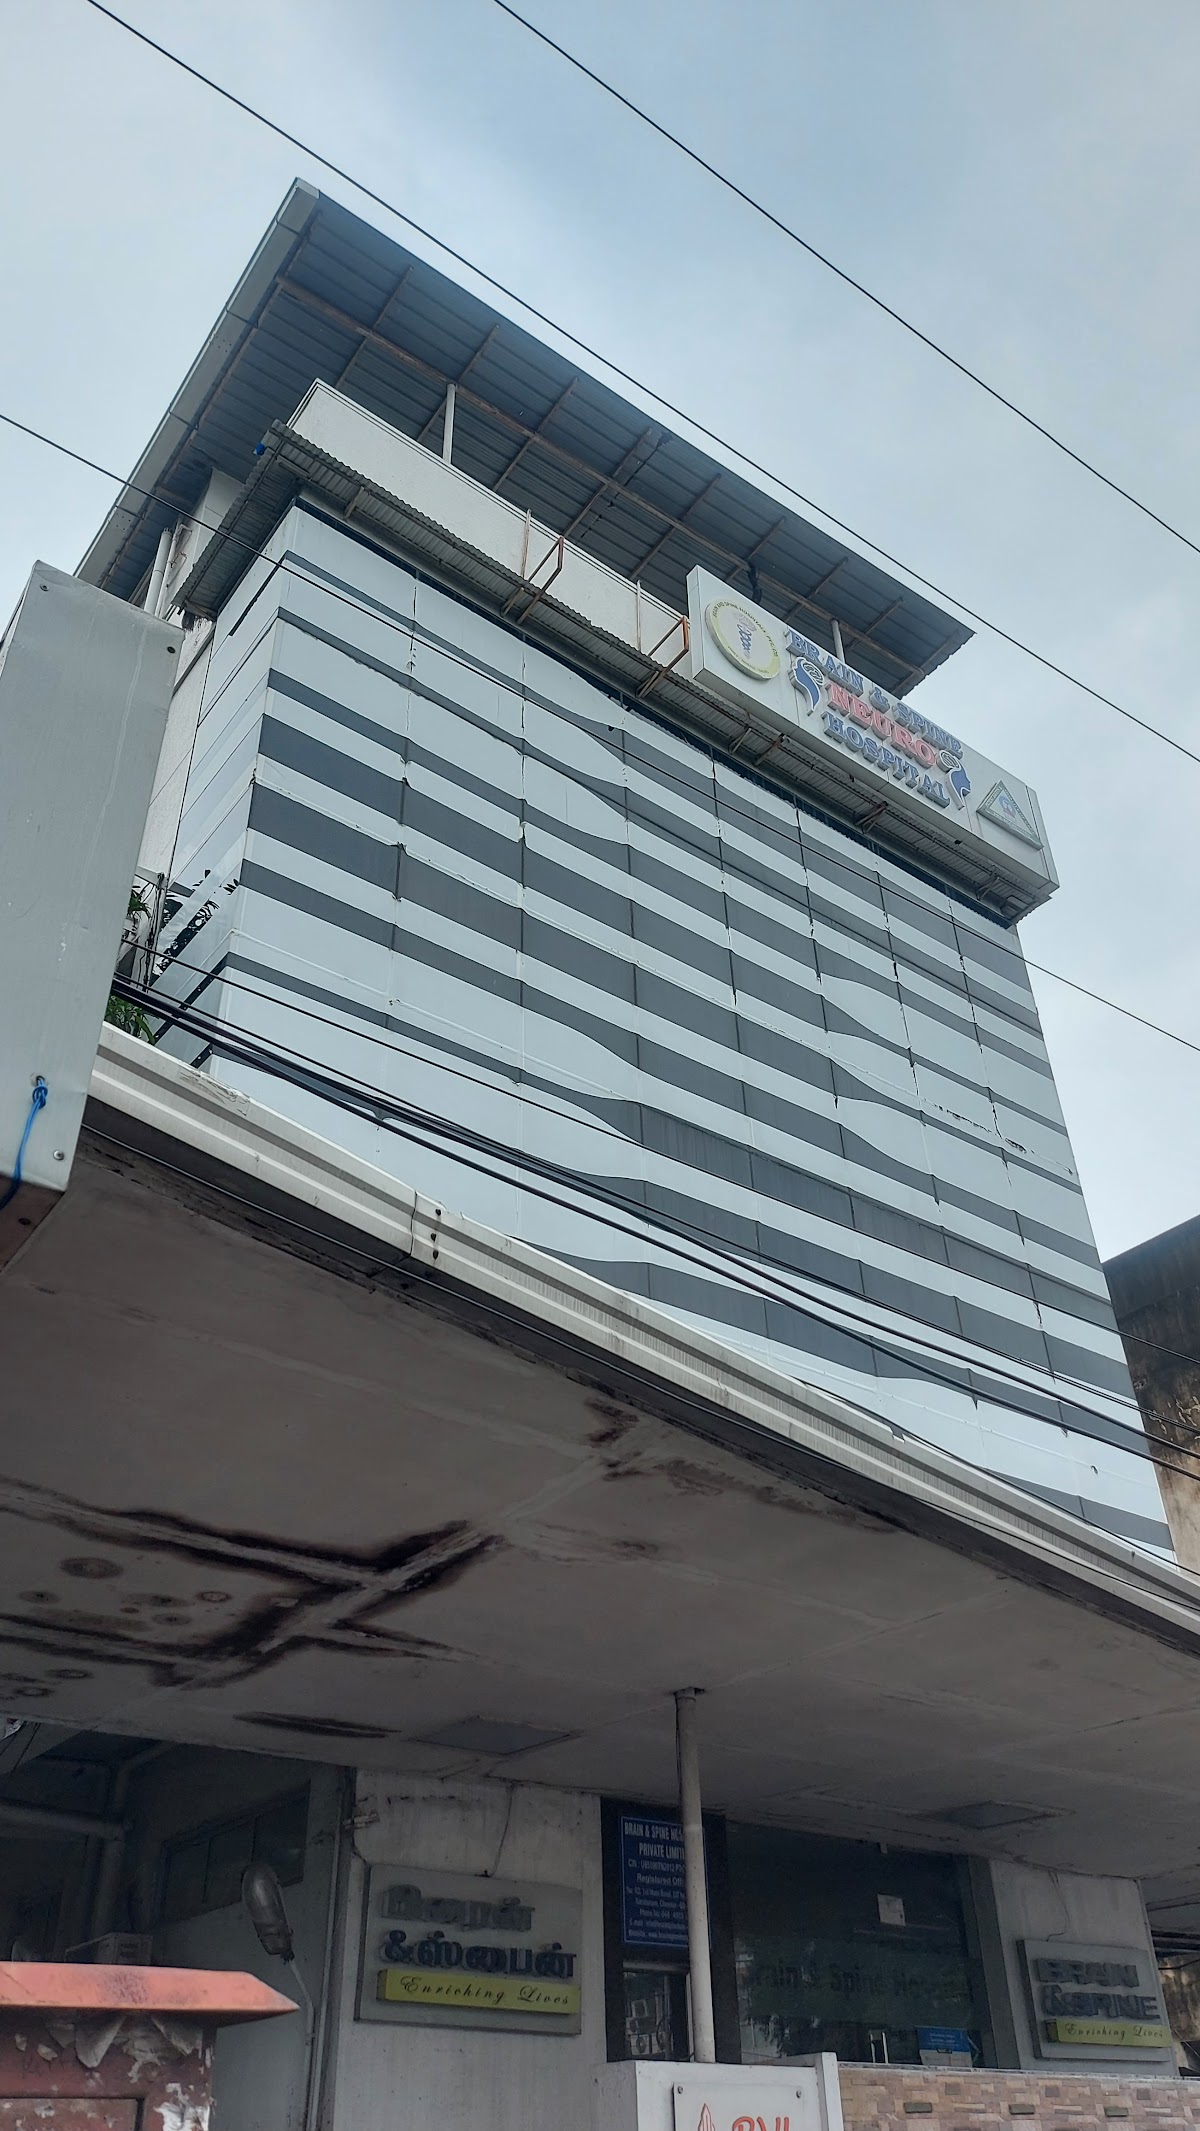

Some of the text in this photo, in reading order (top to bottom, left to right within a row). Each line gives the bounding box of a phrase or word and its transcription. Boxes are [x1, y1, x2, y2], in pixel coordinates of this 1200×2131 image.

[786, 628, 963, 760] BRAIN & SPINE
[826, 680, 937, 769] NEURO
[822, 710, 951, 808] HOSPITAL
[624, 1822, 644, 1837] BRAIN
[645, 1824, 651, 1838] &
[651, 1825, 670, 1840] SPINE
[639, 1842, 665, 1858] PRIVATE
[1036, 1958, 1139, 1988] BRAIN
[400, 1975, 569, 2005] Enriching Lives
[1064, 2023, 1126, 2040] Enriching
